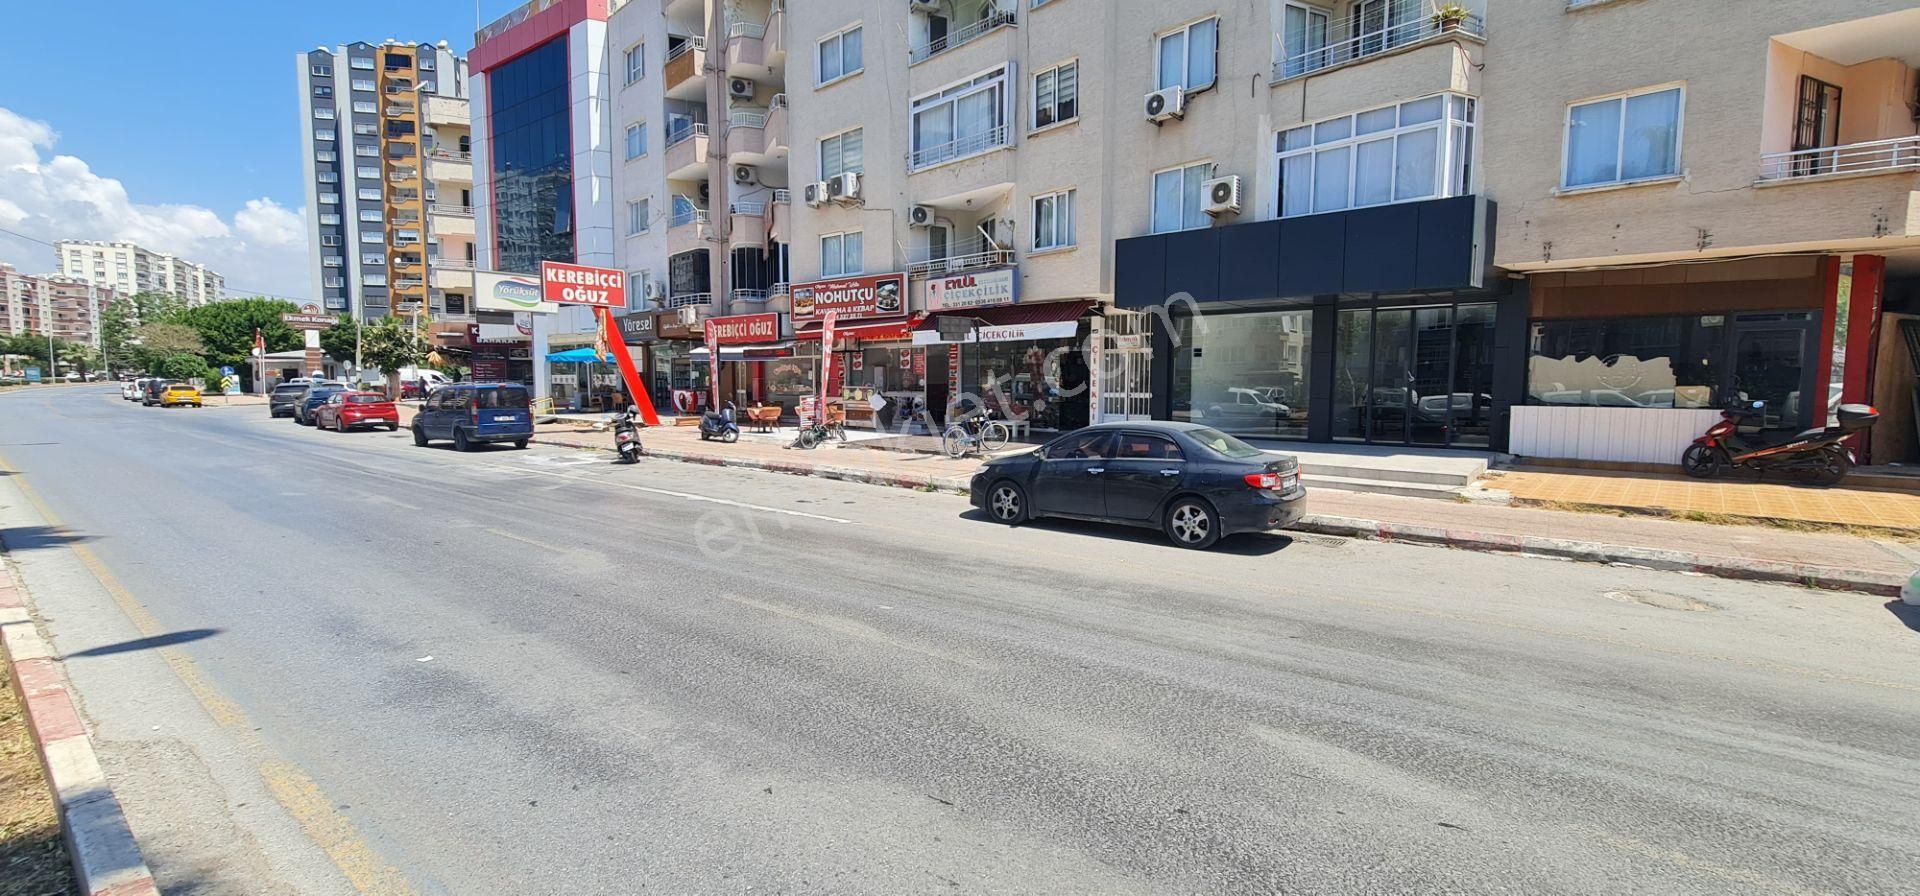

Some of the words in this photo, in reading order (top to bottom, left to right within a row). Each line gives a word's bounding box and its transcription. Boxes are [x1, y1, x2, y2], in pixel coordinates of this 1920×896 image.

[546, 267, 622, 290] KEREBİÇCİ
[945, 274, 977, 290] EYLÜL
[498, 284, 539, 297] Yörüksüt
[562, 285, 609, 304] OĞUZ
[815, 287, 874, 305] NOHUTÇU
[944, 284, 1009, 301] ÇİÇEKÇİLİK
[852, 304, 875, 312] KEBAP
[284, 313, 311, 322] Ekmek
[622, 315, 653, 333] Yöresel
[714, 319, 748, 340] EREBİÇCİ
[749, 318, 773, 337] OĞUZ
